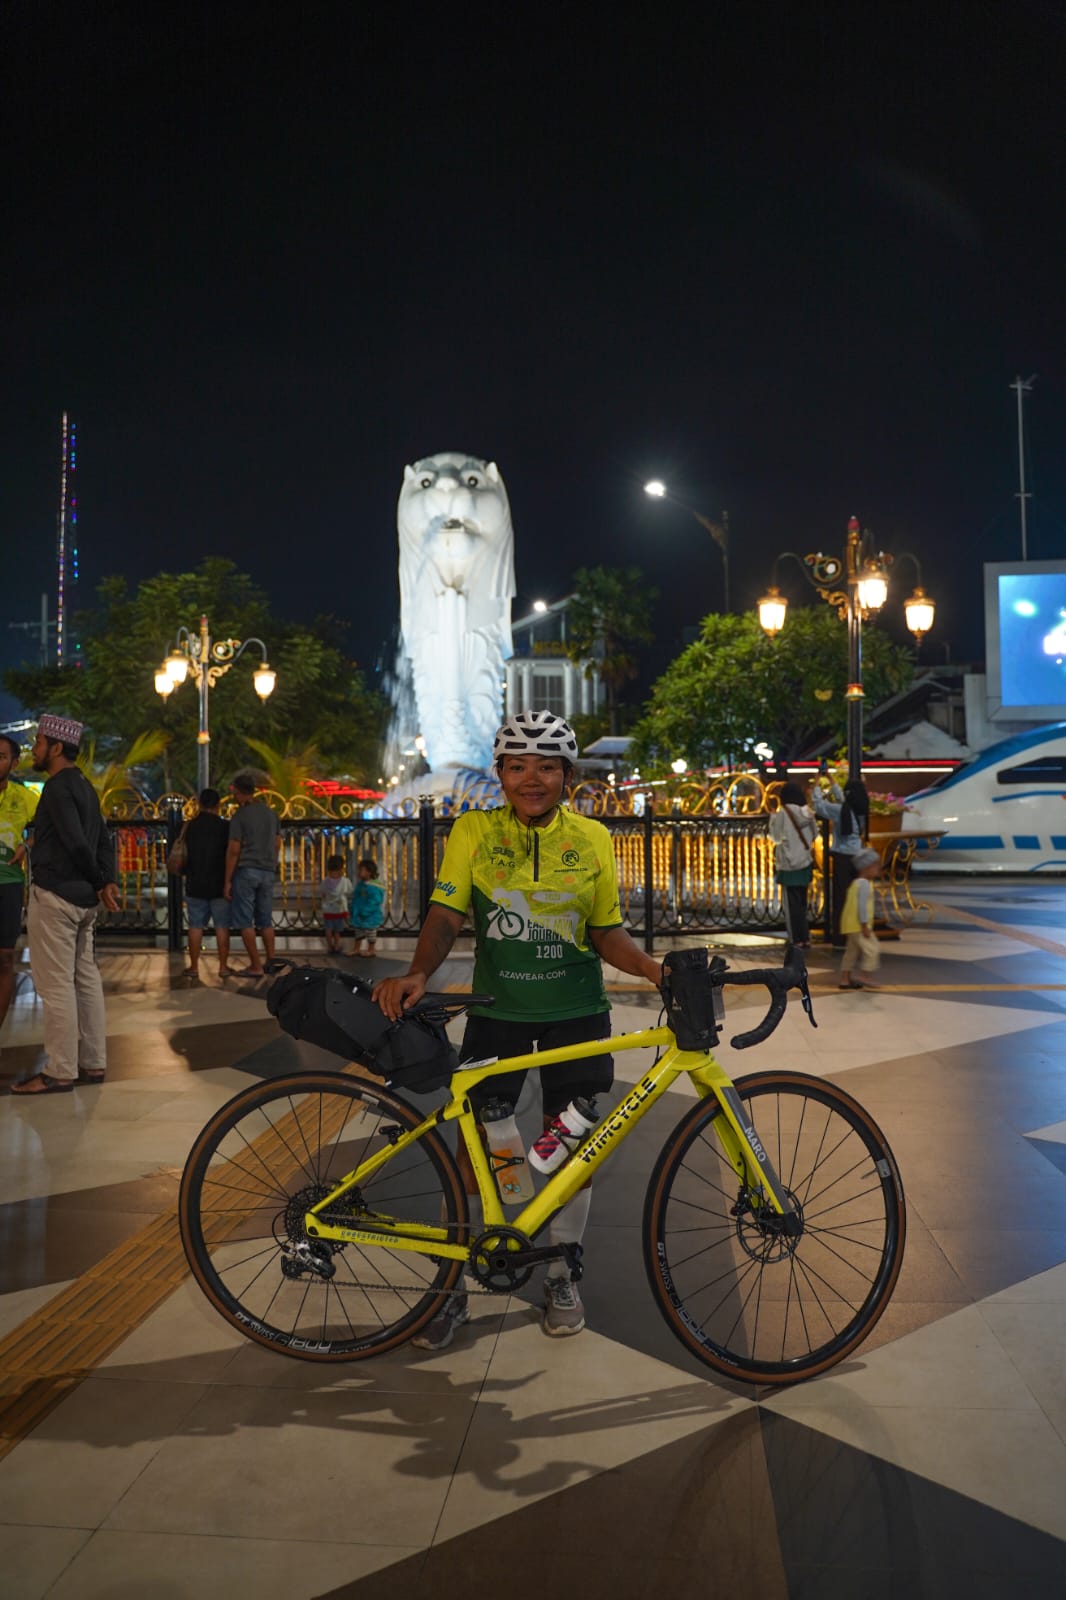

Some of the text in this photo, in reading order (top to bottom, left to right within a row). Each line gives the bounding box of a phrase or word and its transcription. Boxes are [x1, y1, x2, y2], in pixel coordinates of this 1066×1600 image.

[535, 944, 563, 959] 1200
[498, 969, 567, 981] AZAWEAR.COM
[578, 1077, 657, 1163] WIMCYCLE
[744, 1126, 767, 1162] MARO
[656, 1241, 666, 1256] DT
[234, 1311, 250, 1324] DT
[249, 1321, 275, 1341] SWISS
